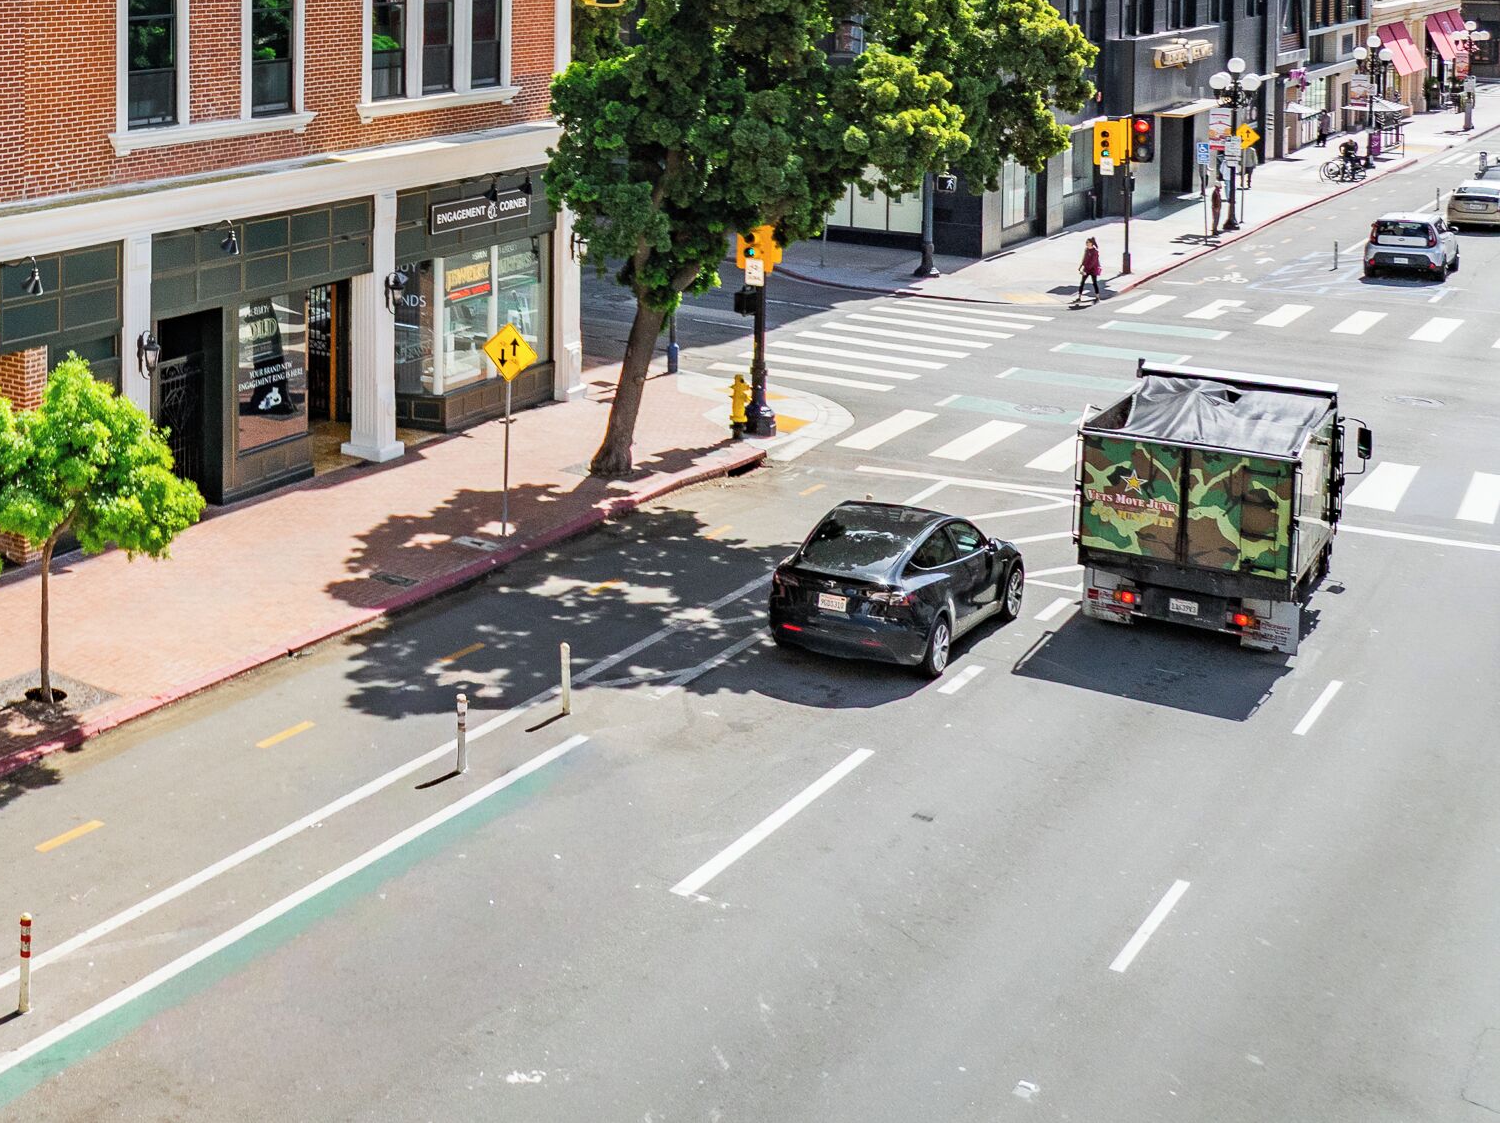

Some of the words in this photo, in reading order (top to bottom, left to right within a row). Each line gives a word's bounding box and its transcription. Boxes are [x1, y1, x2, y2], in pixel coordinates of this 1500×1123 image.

[436, 205, 486, 225] ENGAGEMENT
[499, 197, 527, 212] CORNER
[1087, 489, 1113, 502] VETS
[1115, 493, 1145, 508] MOVE
[1146, 499, 1176, 513] JUNK
